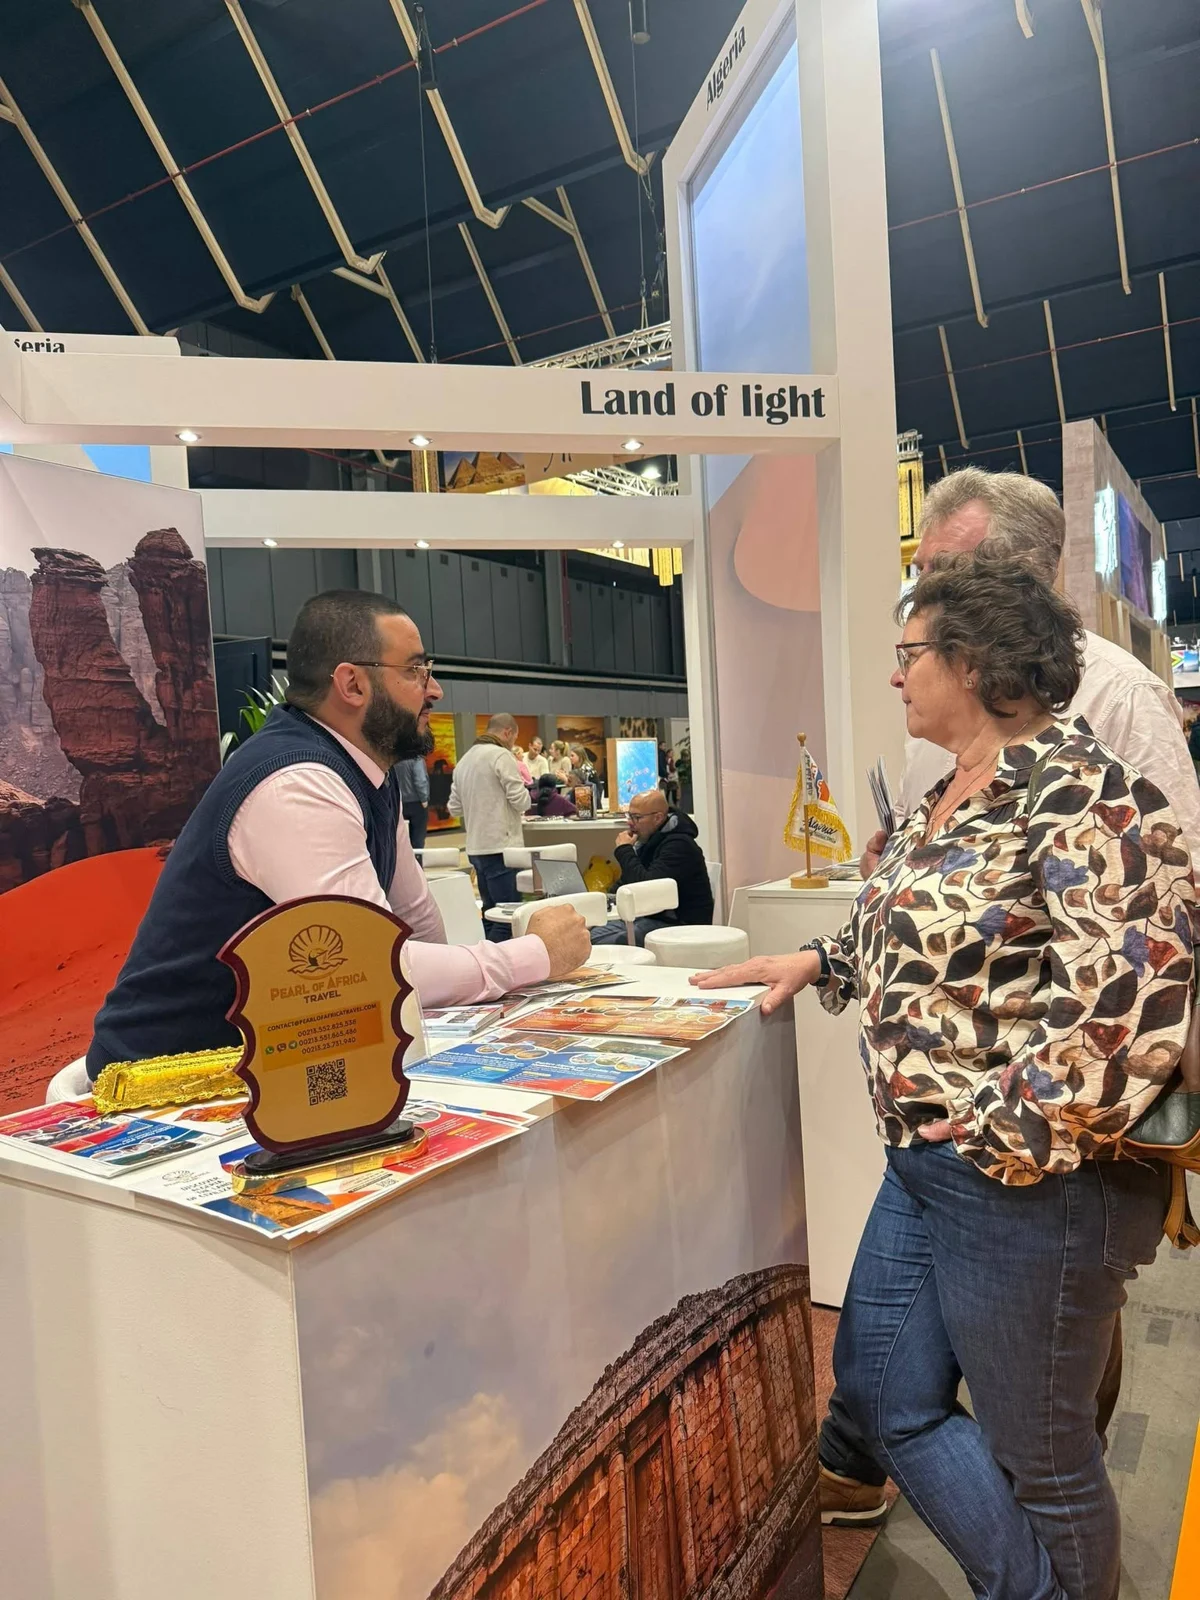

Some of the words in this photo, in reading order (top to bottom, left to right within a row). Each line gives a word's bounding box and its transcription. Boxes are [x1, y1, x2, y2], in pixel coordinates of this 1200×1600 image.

[706, 26, 746, 111] Algeria
[581, 381, 676, 416] Land
[691, 384, 728, 417] of
[742, 384, 826, 425] light
[270, 984, 310, 1001] PEARL
[312, 982, 325, 992] OF
[327, 971, 368, 990] AFRICA
[304, 989, 341, 1004] TRAVEL
